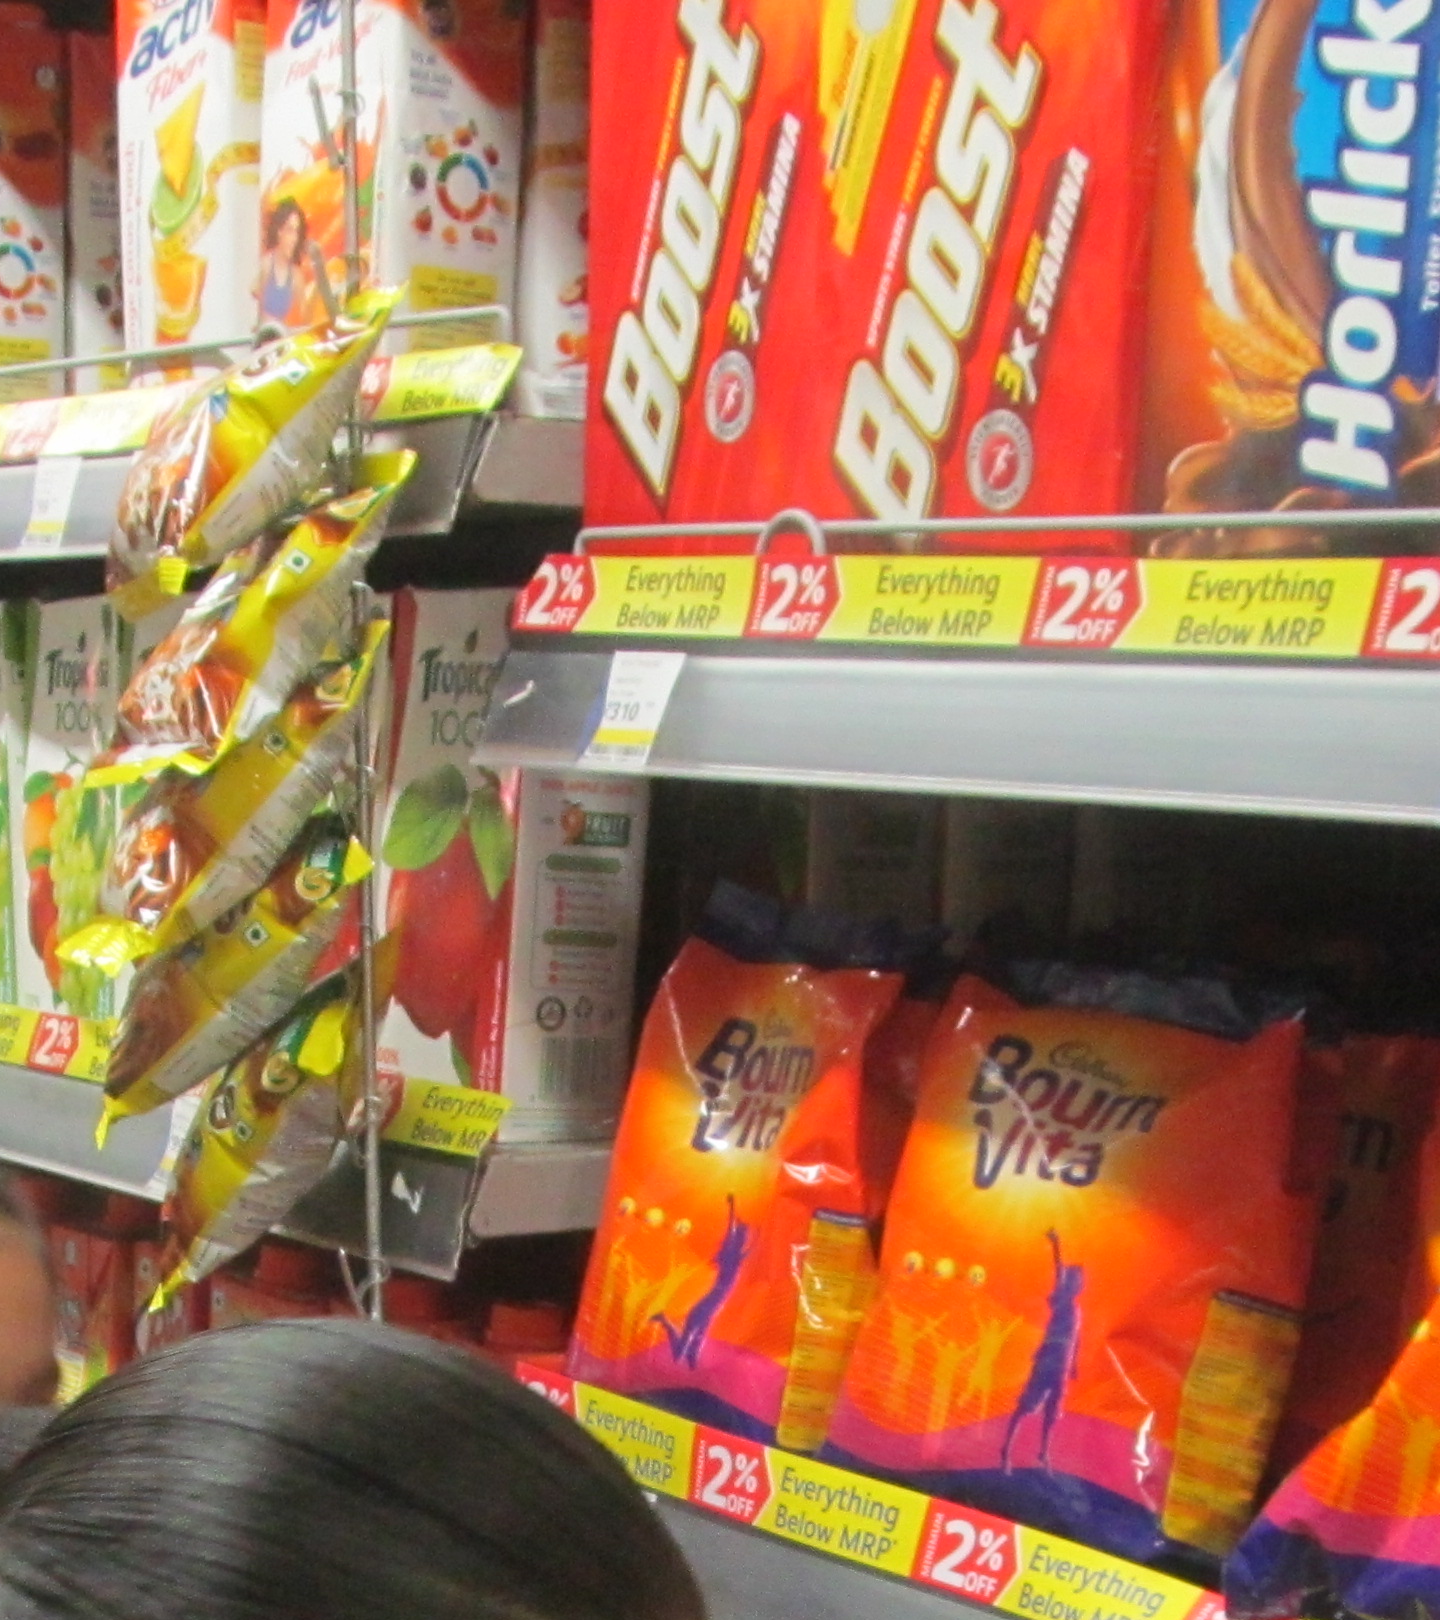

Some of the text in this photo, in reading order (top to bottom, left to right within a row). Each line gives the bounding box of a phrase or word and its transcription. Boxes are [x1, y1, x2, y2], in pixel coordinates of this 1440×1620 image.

[751, 110, 803, 283] STAMINA
[604, 0, 760, 497] Boost
[1028, 145, 1092, 334] STAMINA
[833, 0, 1042, 552] Boost
[526, 562, 584, 625] 2%
[624, 566, 726, 598] Everything
[761, 563, 827, 634] 2%
[876, 566, 1001, 604] Everything
[1046, 566, 1129, 641] 2%
[1186, 570, 1336, 611] Everything
[549, 606, 579, 627] OFF
[616, 604, 670, 629] Below
[788, 611, 822, 634] OFF
[868, 611, 933, 637] Below
[1077, 618, 1117, 642] OFF
[1174, 615, 1258, 646] Below
[32, 1017, 74, 1067] 2%
[970, 1034, 1168, 1134] Bourn
[971, 1110, 1105, 1190] Vita
[585, 1400, 676, 1460] Everything
[701, 1444, 759, 1507] 2%
[726, 1492, 755, 1517] OFF
[780, 1468, 901, 1532] Everything
[775, 1506, 837, 1546] Below
[931, 1519, 1004, 1588] 2%
[960, 1570, 997, 1597] OFF
[1029, 1545, 1166, 1618] Everything
